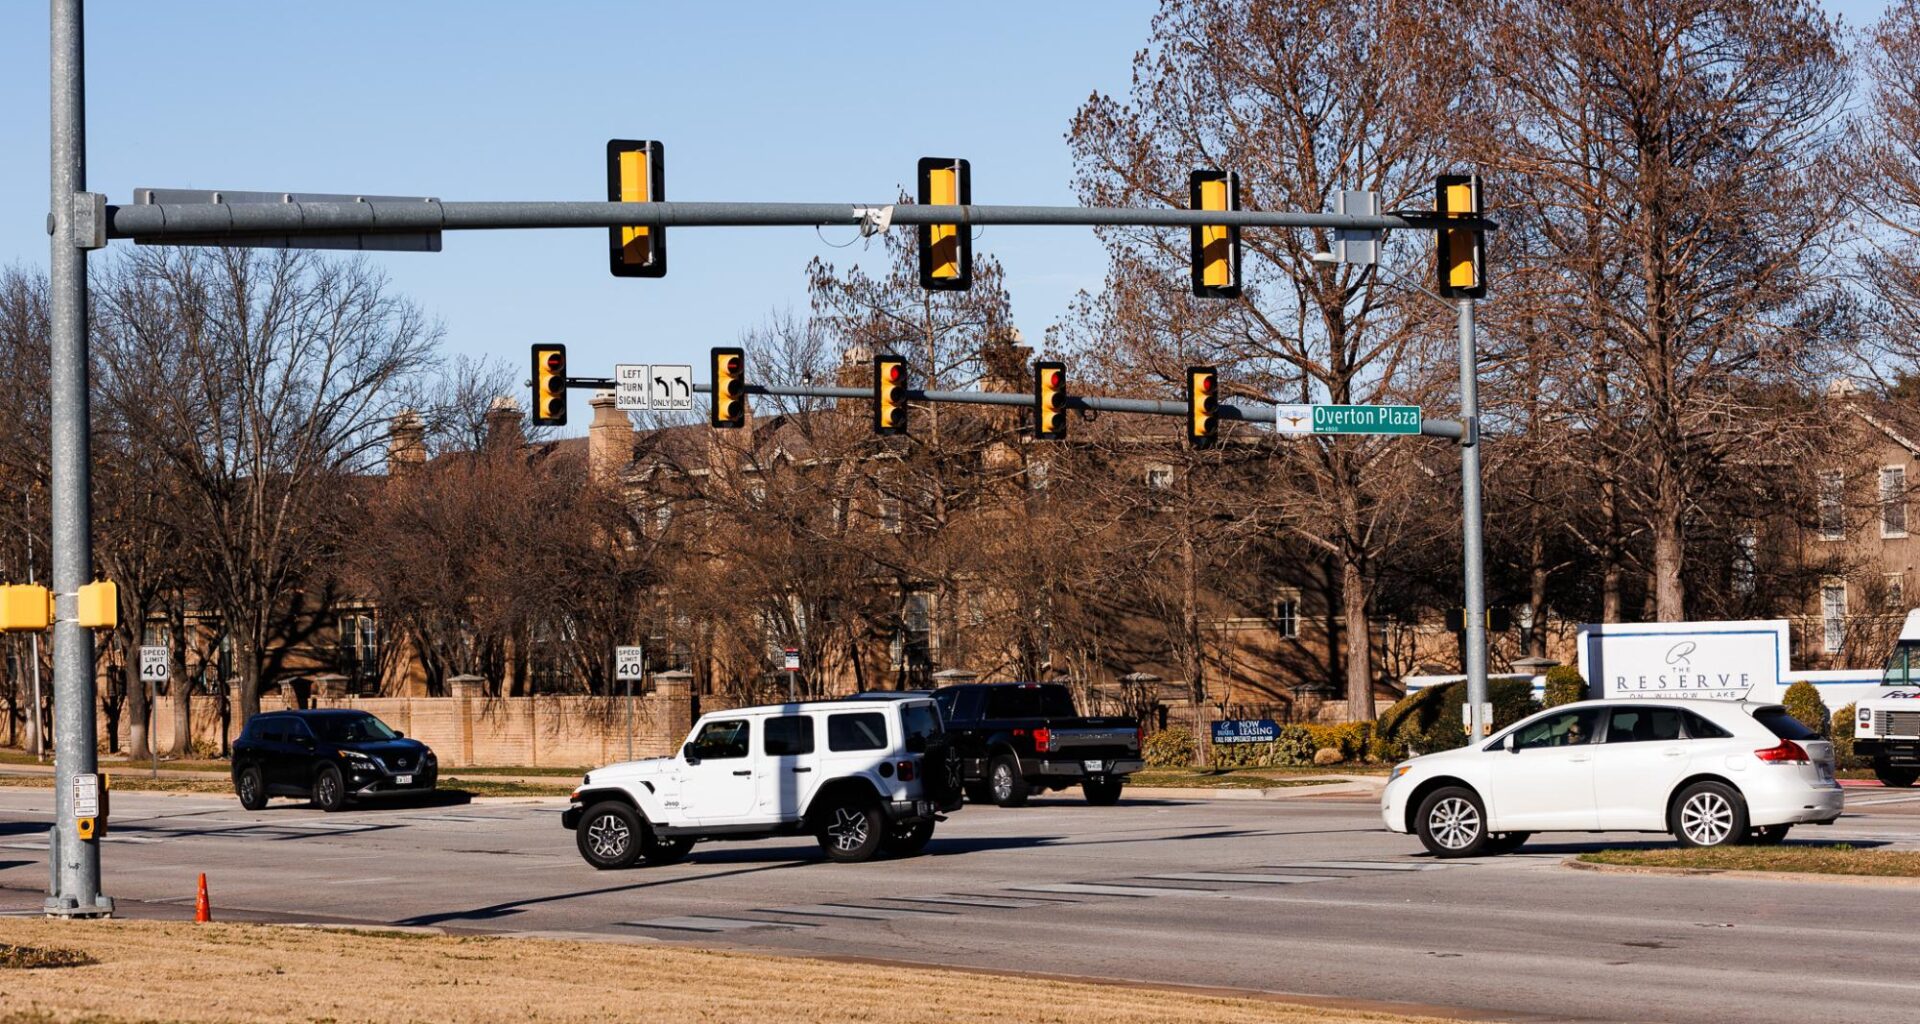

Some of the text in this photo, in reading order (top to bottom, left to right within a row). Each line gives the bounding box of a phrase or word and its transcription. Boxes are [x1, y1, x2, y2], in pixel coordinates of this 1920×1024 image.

[623, 369, 641, 379] LEFT
[623, 383, 643, 391] TURN
[618, 395, 647, 405] SIGNAL
[653, 398, 690, 407] ONLY ONLY
[1315, 406, 1418, 425] Overton Plaza
[143, 664, 166, 677] 40
[618, 663, 640, 676] 40
[1616, 673, 1749, 690] RESERVE
[1710, 691, 1736, 699] LAKE
[1239, 720, 1260, 729] NOW
[1239, 727, 1273, 736] LEASING
